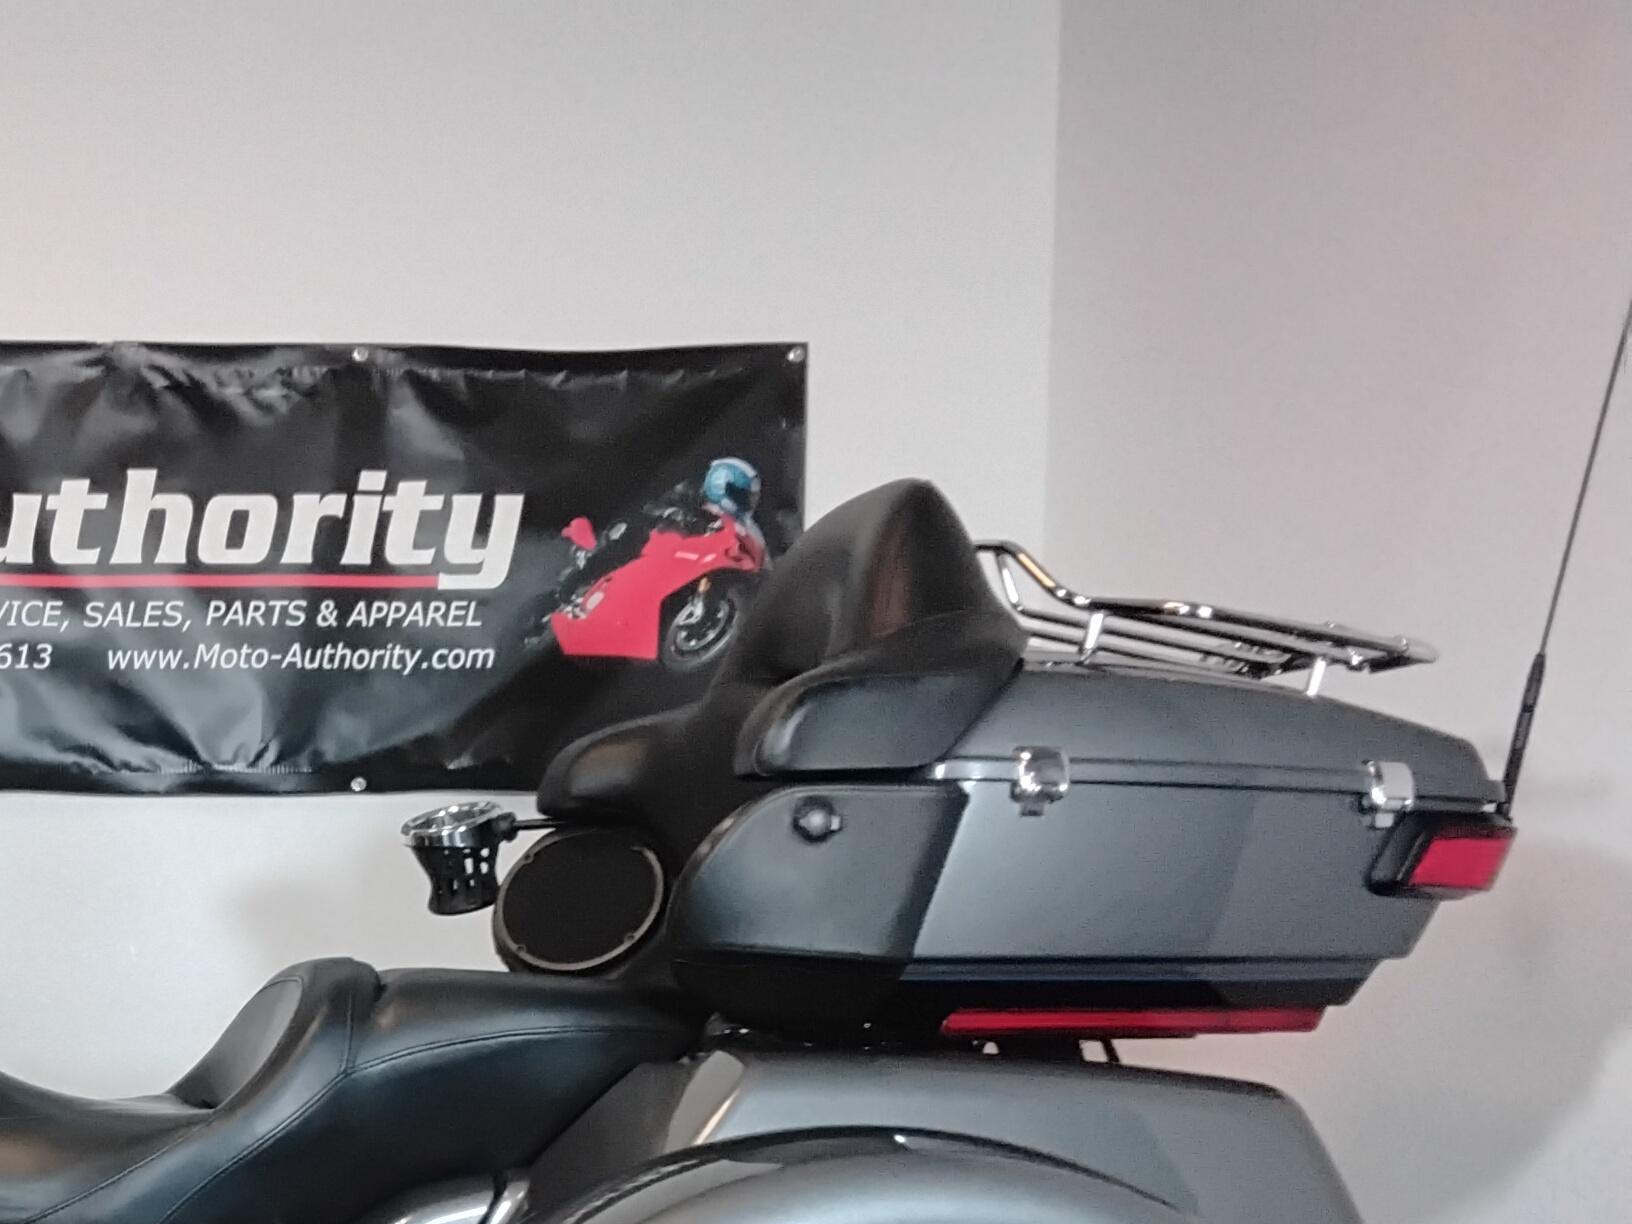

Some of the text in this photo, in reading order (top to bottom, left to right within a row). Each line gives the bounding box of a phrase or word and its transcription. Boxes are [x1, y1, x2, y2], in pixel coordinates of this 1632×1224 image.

[83, 600, 192, 633] SALES,
[205, 600, 307, 627] PARTS
[316, 600, 338, 627] &
[346, 600, 483, 627] APPAREL
[107, 642, 495, 676] www.Moto-Authority.com
